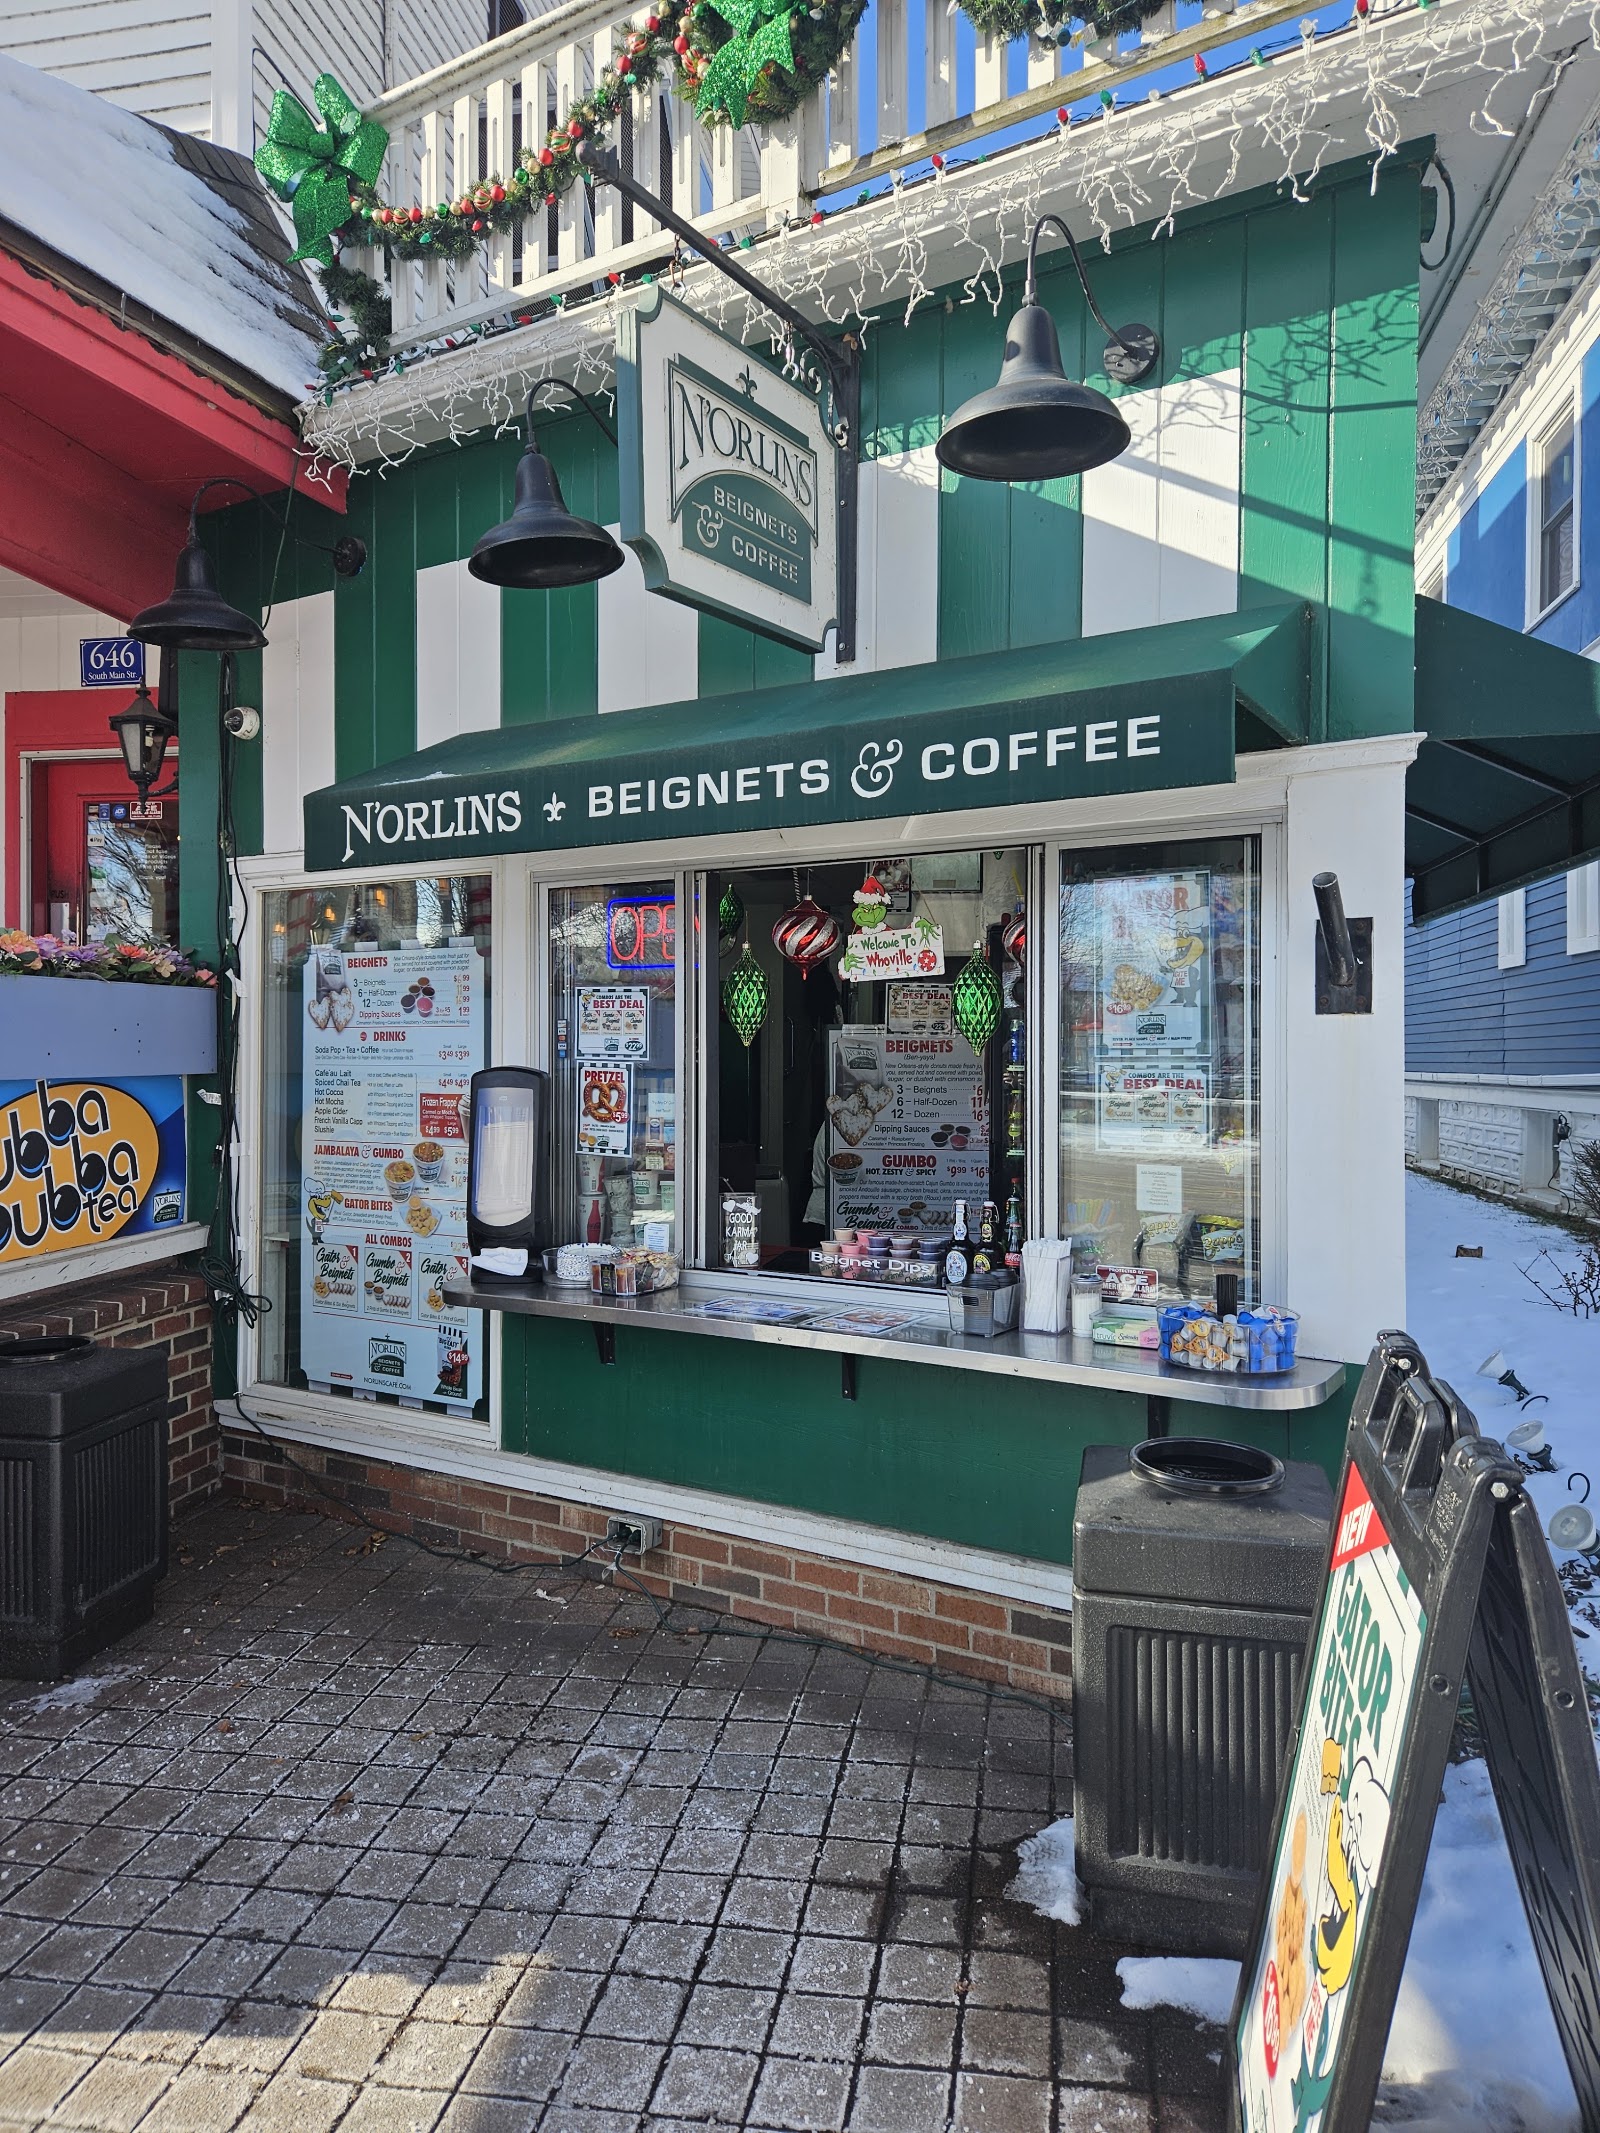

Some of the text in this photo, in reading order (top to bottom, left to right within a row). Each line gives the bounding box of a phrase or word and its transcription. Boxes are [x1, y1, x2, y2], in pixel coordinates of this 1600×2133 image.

[713, 485, 798, 545] BEIGNETS
[691, 501, 798, 584] & COFFEE
[89, 641, 135, 670] 646
[88, 670, 138, 681] South Main Str.
[588, 758, 831, 818] BEIGNETS
[850, 738, 903, 799] &
[921, 714, 1161, 781] COFFEE
[611, 904, 676, 961] OPE
[860, 934, 917, 951] Welcome To
[348, 956, 388, 969] BEIGNETS
[866, 949, 913, 968] Whoville
[353, 979, 387, 987] 3 Beignets
[1175, 978, 1185, 986] ME
[358, 988, 397, 998] 6 Half-Dozen
[363, 999, 395, 1007] 12 Dozen
[593, 1000, 644, 1008] BEST DEAL
[359, 1010, 401, 1019] Dipping Sauces
[373, 1031, 406, 1041] DRINKS
[315, 1046, 329, 1054] Soda
[330, 1046, 341, 1055] Pop
[346, 1046, 356, 1054] Tea
[360, 1046, 380, 1054] Coffee
[439, 1050, 453, 1060] $349
[455, 1050, 470, 1060] $399
[886, 1040, 954, 1053] BEIGNETS
[339, 1069, 352, 1077] Lait
[584, 1070, 625, 1084] PRETZEL
[314, 1078, 334, 1087] Spiced
[351, 1079, 361, 1087] Tea
[439, 1079, 453, 1088] $449
[455, 1079, 470, 1089] $499
[896, 1084, 948, 1095] 3 Beignets
[1123, 1079, 1204, 1090] BEST DEAL
[314, 1088, 344, 1096] Hot Cocoa
[314, 1097, 344, 1105] Hot Mocha
[422, 1096, 439, 1106] Frozen
[896, 1097, 958, 1107] 6 Half-Dozen
[314, 1107, 348, 1115] Apple Cider
[613, 1110, 628, 1123] $599
[891, 1109, 940, 1119] 12 Dozen
[314, 1116, 363, 1126] French Vanilla Capp
[425, 1126, 459, 1136] $499 $599
[874, 1125, 930, 1134] Dipping Sauces
[314, 1144, 359, 1157] JAMBALAYA
[373, 1147, 404, 1159] GUMBO
[882, 1155, 937, 1168] GUMBO
[905, 1168, 914, 1177] &
[946, 1166, 967, 1178] $999
[82, 1185, 138, 1234] tea
[344, 1198, 393, 1211] GATOR BITES
[836, 1201, 880, 1217] Gumbo
[729, 1213, 752, 1223] GOOD
[845, 1214, 898, 1231] Beignets
[725, 1226, 756, 1238] KARMA
[365, 1233, 412, 1247] ALL COMBOS
[316, 1247, 341, 1264] Gator
[366, 1252, 396, 1269] Gumbo
[405, 1253, 411, 1263] 2
[421, 1258, 448, 1275] Gator
[461, 1258, 467, 1268] 3
[811, 1251, 881, 1268] Beignet
[888, 1260, 930, 1274] Dips
[320, 1263, 356, 1283] Beignets
[373, 1268, 410, 1289] Beignets
[904, 1272, 934, 1283] Chocolate
[1105, 1272, 1149, 1286] ACE
[1117, 1332, 1139, 1341] Splenda
[378, 1358, 401, 1366] BEIGNETS
[448, 1352, 468, 1363] $1499
[382, 1366, 400, 1374] COFFEE
[363, 1377, 412, 1390] NORLINSCAFE.COM
[1336, 1500, 1374, 1557] NEW
[1336, 1558, 1393, 1760] GATOR
[1319, 1627, 1362, 1804] BITES
